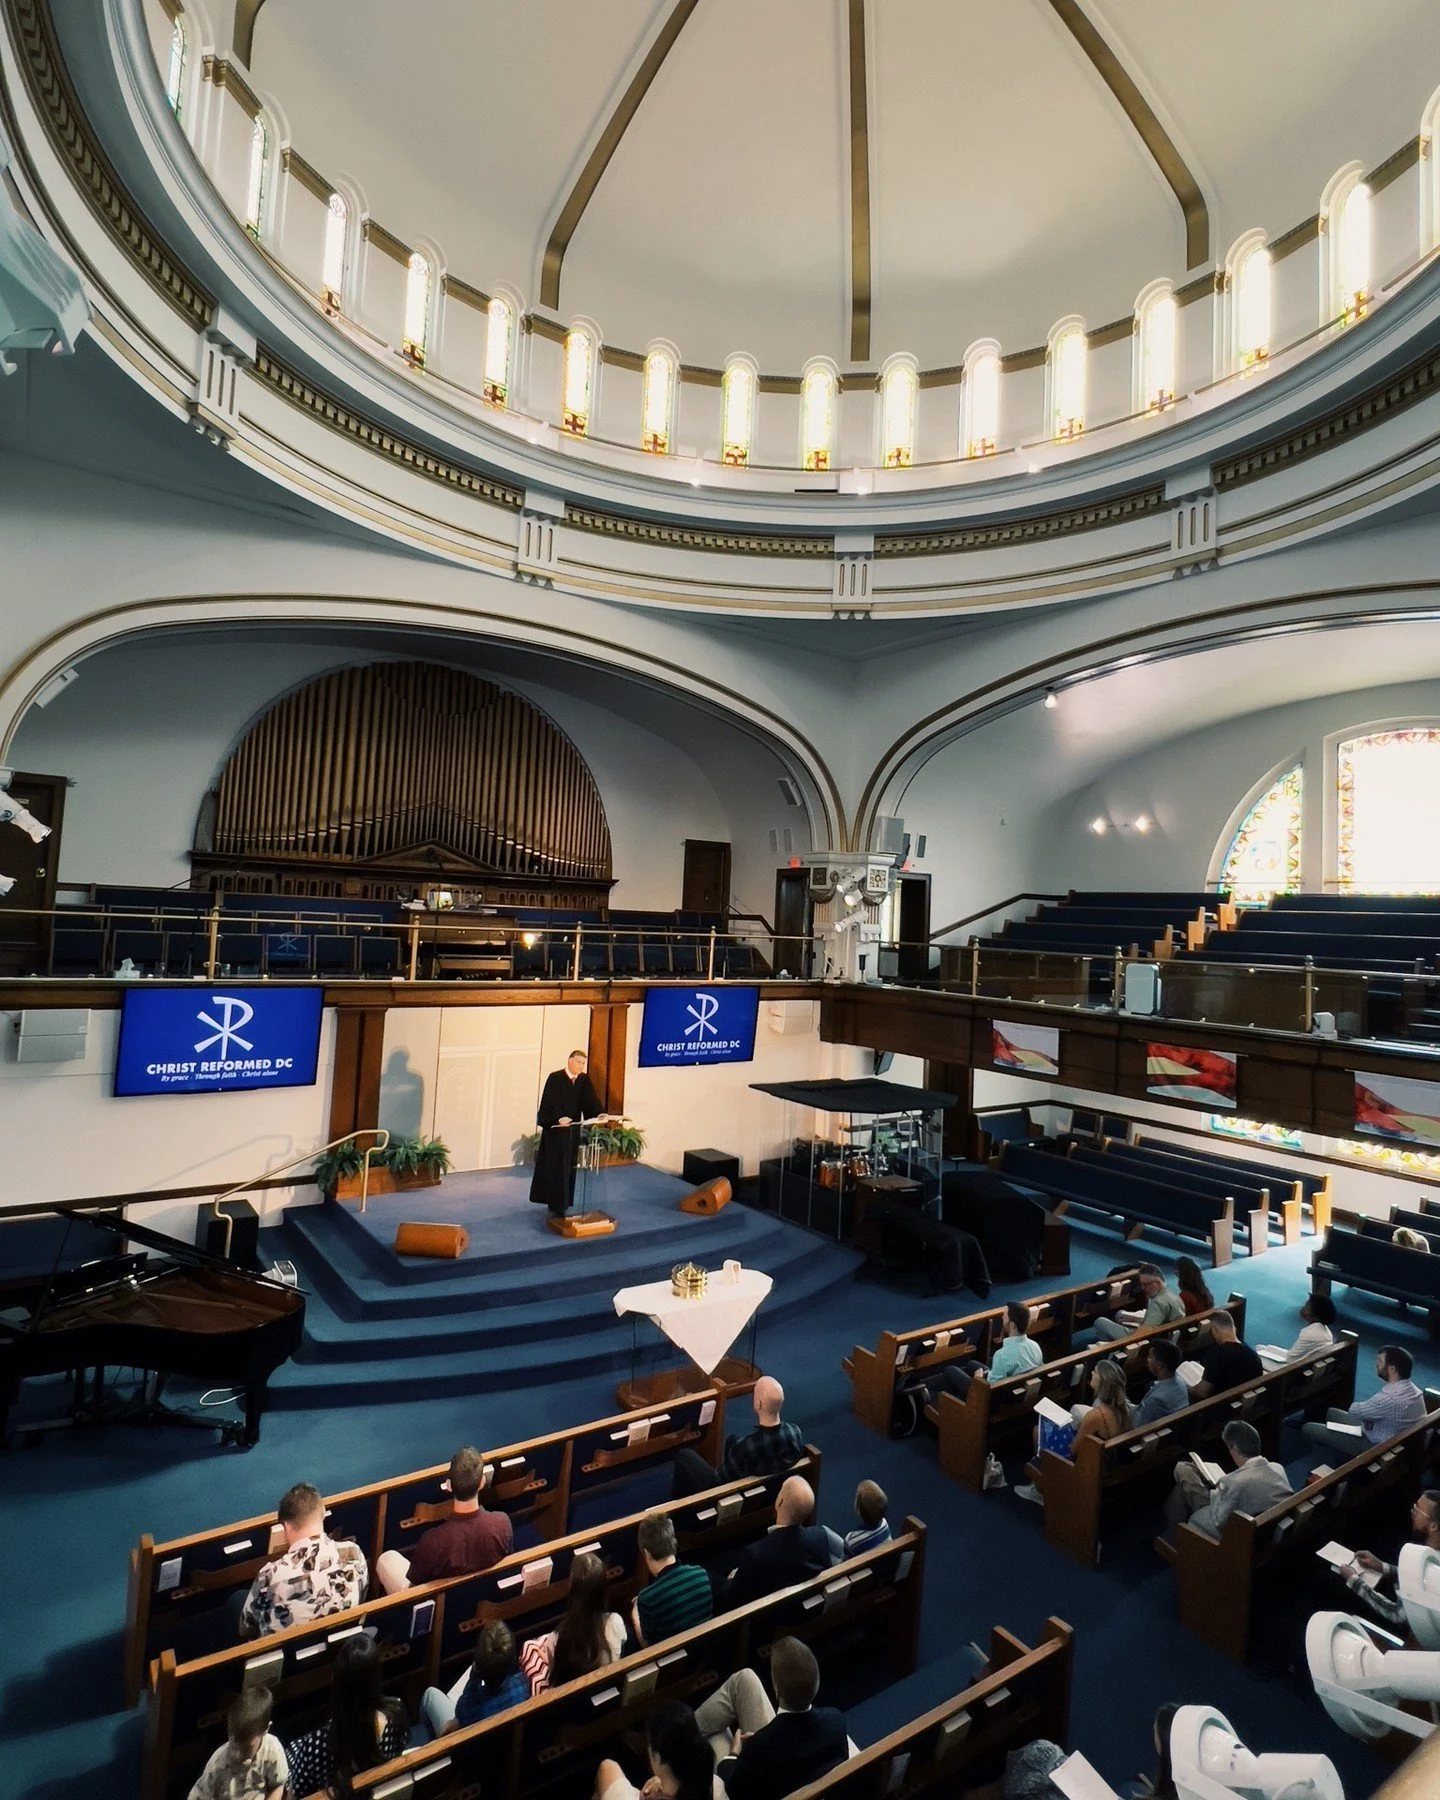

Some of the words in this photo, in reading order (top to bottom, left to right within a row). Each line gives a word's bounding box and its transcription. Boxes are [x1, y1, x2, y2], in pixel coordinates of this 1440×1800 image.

[657, 1043, 685, 1052] CHRIST
[687, 1041, 728, 1050] REFORMED
[730, 1040, 740, 1048] DC
[146, 1062, 197, 1075] CHRIST
[200, 1059, 271, 1072] REFORMED
[275, 1058, 293, 1069] DC
[195, 1072, 221, 1081] Through
[221, 1071, 237, 1080] faith
[242, 1070, 261, 1078] Christ
